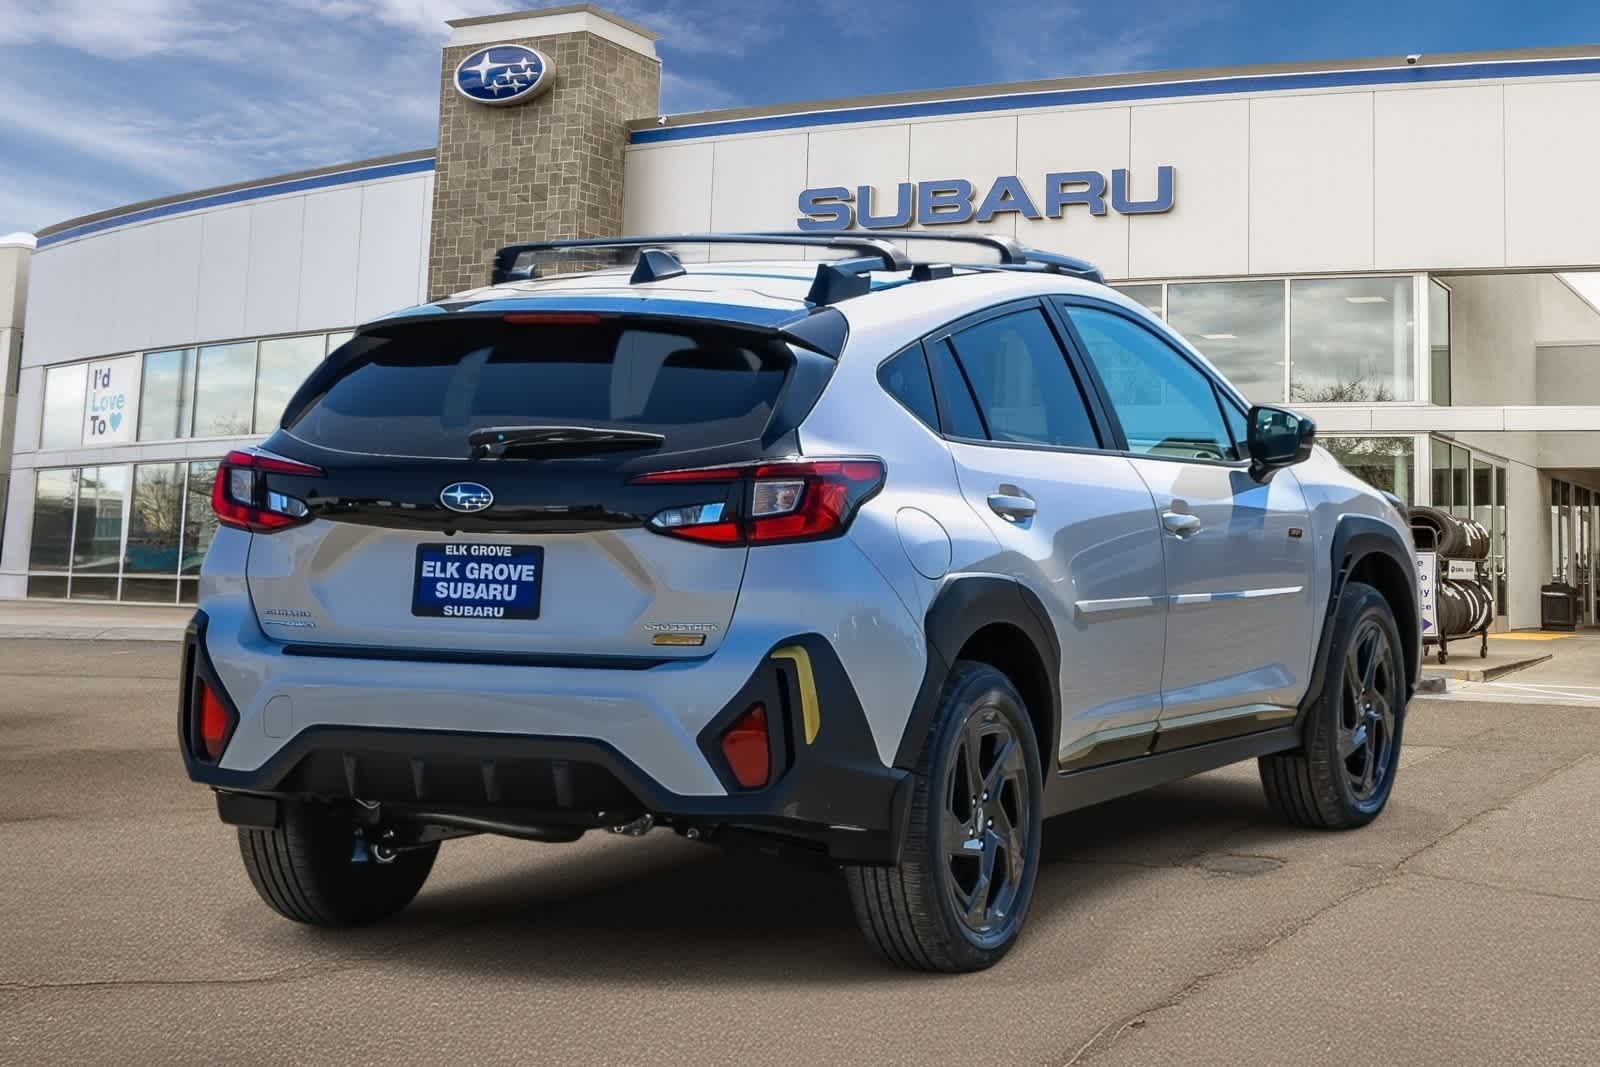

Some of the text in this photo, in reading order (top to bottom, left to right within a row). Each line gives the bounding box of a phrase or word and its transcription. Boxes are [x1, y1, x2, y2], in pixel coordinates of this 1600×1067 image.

[797, 165, 1175, 231] SUBARU
[94, 368, 111, 390] I'd
[92, 392, 125, 412] Love
[90, 416, 106, 435] To
[445, 545, 512, 556] ELK GROVE
[422, 561, 535, 581] ELK GROVE
[435, 582, 517, 601] SUBARU
[443, 605, 504, 617] SUBARU
